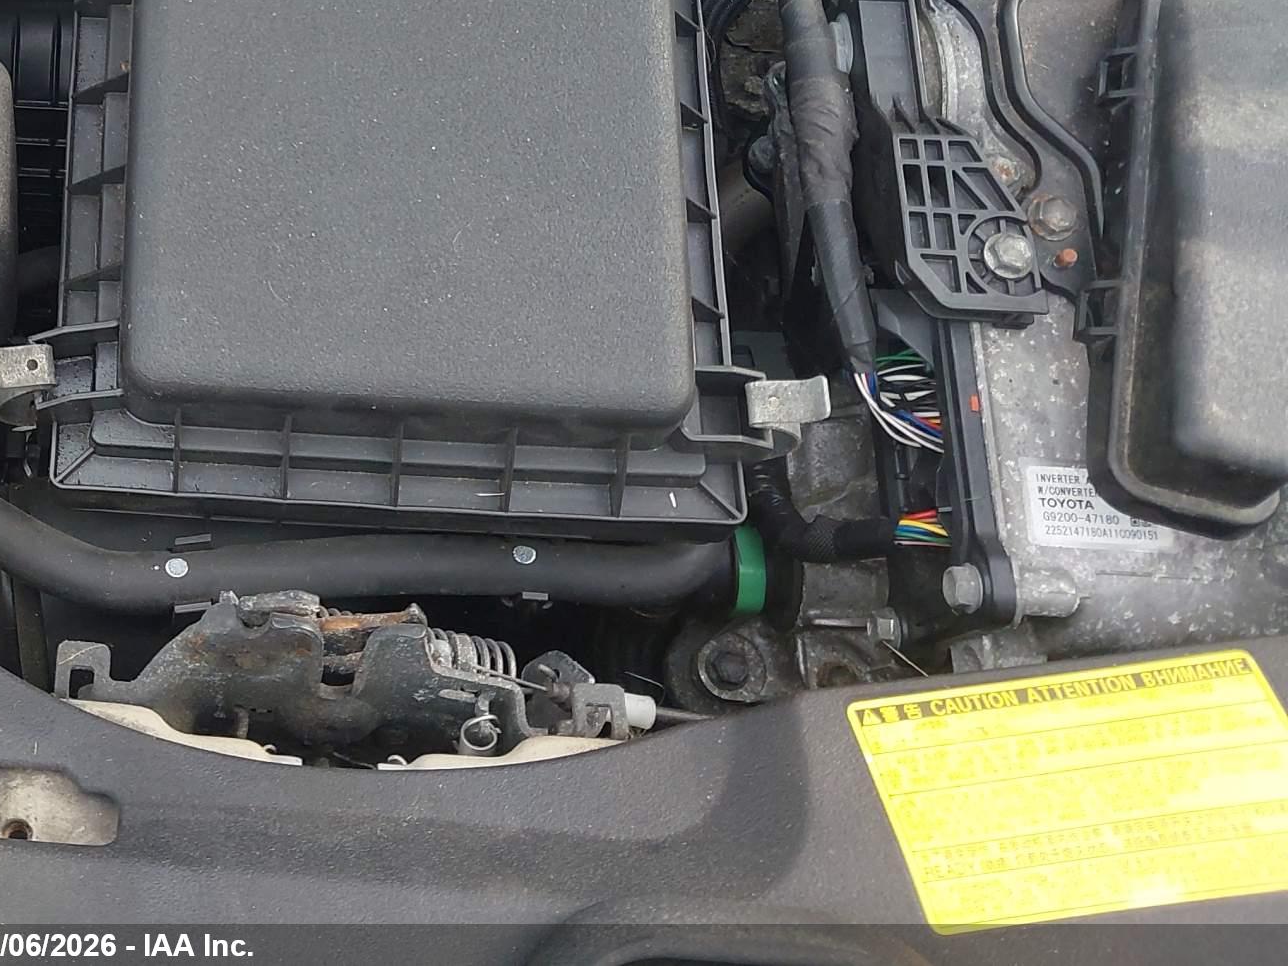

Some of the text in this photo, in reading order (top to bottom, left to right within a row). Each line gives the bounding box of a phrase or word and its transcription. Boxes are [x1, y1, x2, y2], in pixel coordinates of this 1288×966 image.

[1035, 473, 1081, 484] INVERTER
[1037, 485, 1097, 498] W/CONVERTE
[1038, 497, 1094, 510] TOYOTA
[1043, 510, 1120, 525] G9200-47180
[929, 690, 1022, 717] CAUTION
[1027, 674, 1138, 704] ATTENTION
